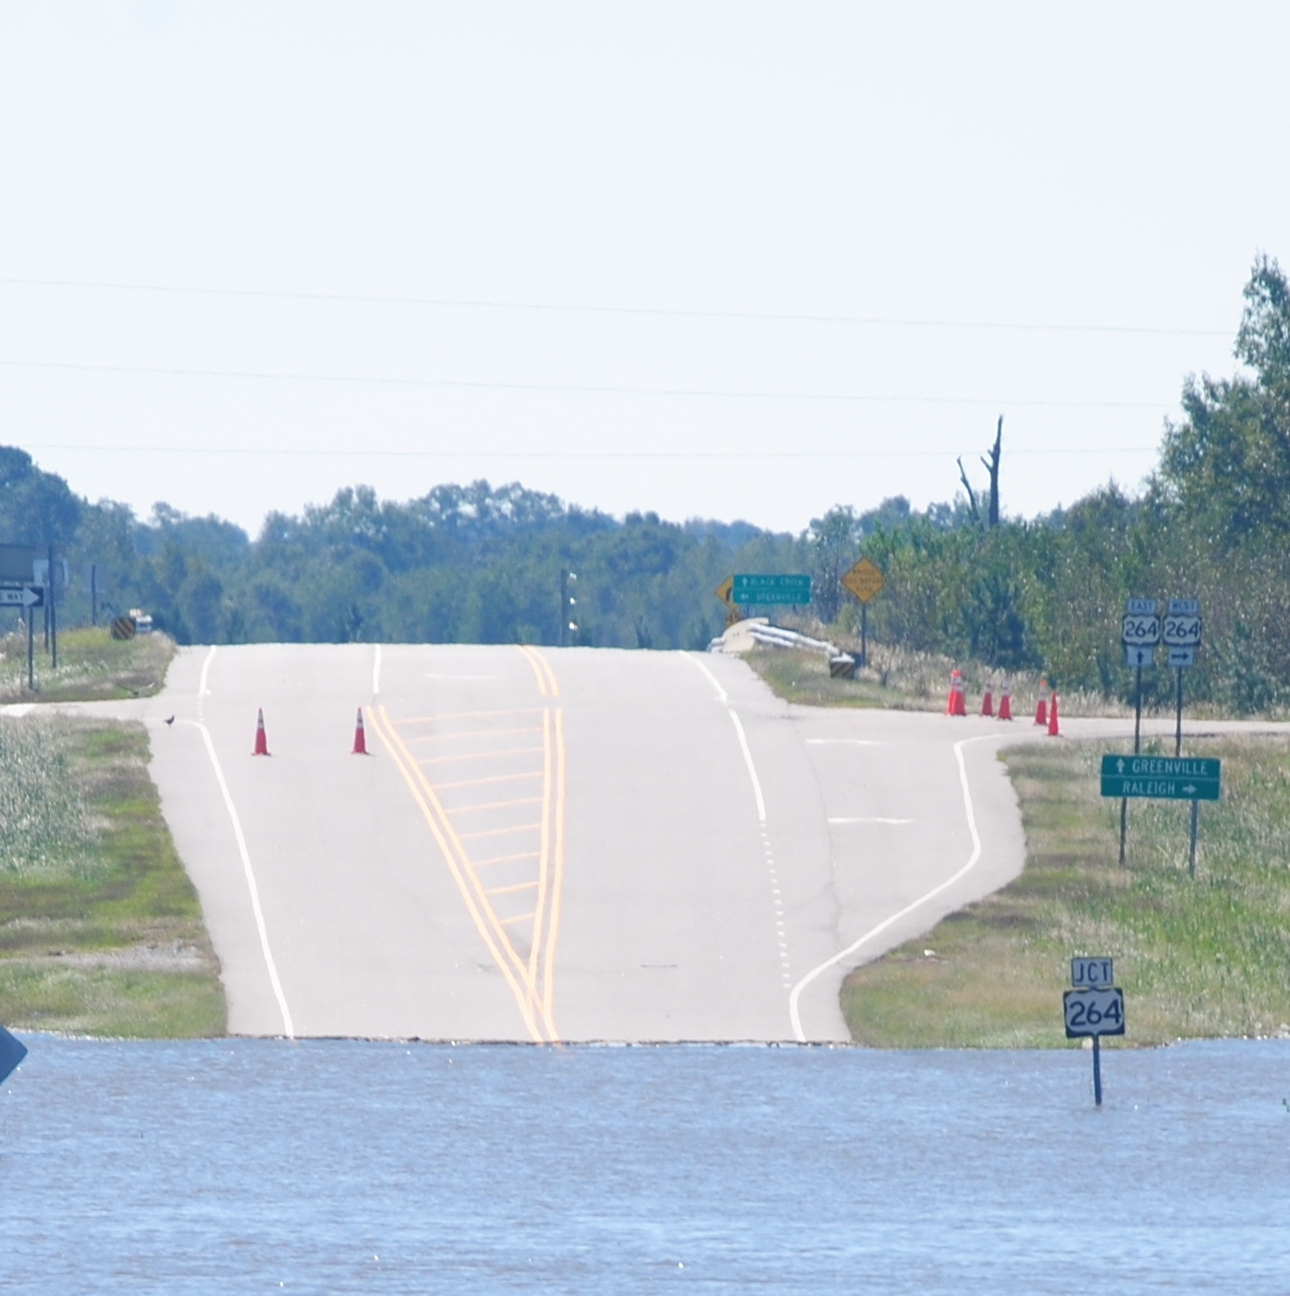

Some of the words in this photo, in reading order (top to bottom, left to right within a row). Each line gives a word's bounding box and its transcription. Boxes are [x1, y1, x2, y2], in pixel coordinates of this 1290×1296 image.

[7, 592, 24, 601] WAY
[1131, 600, 1154, 610] EAST
[1125, 620, 1156, 637] 264
[1166, 621, 1199, 637] 264
[1132, 759, 1208, 775] GREENVILLE
[1122, 780, 1175, 795] RALEIGH
[1074, 961, 1109, 983] JCT
[1070, 999, 1122, 1026] 264
